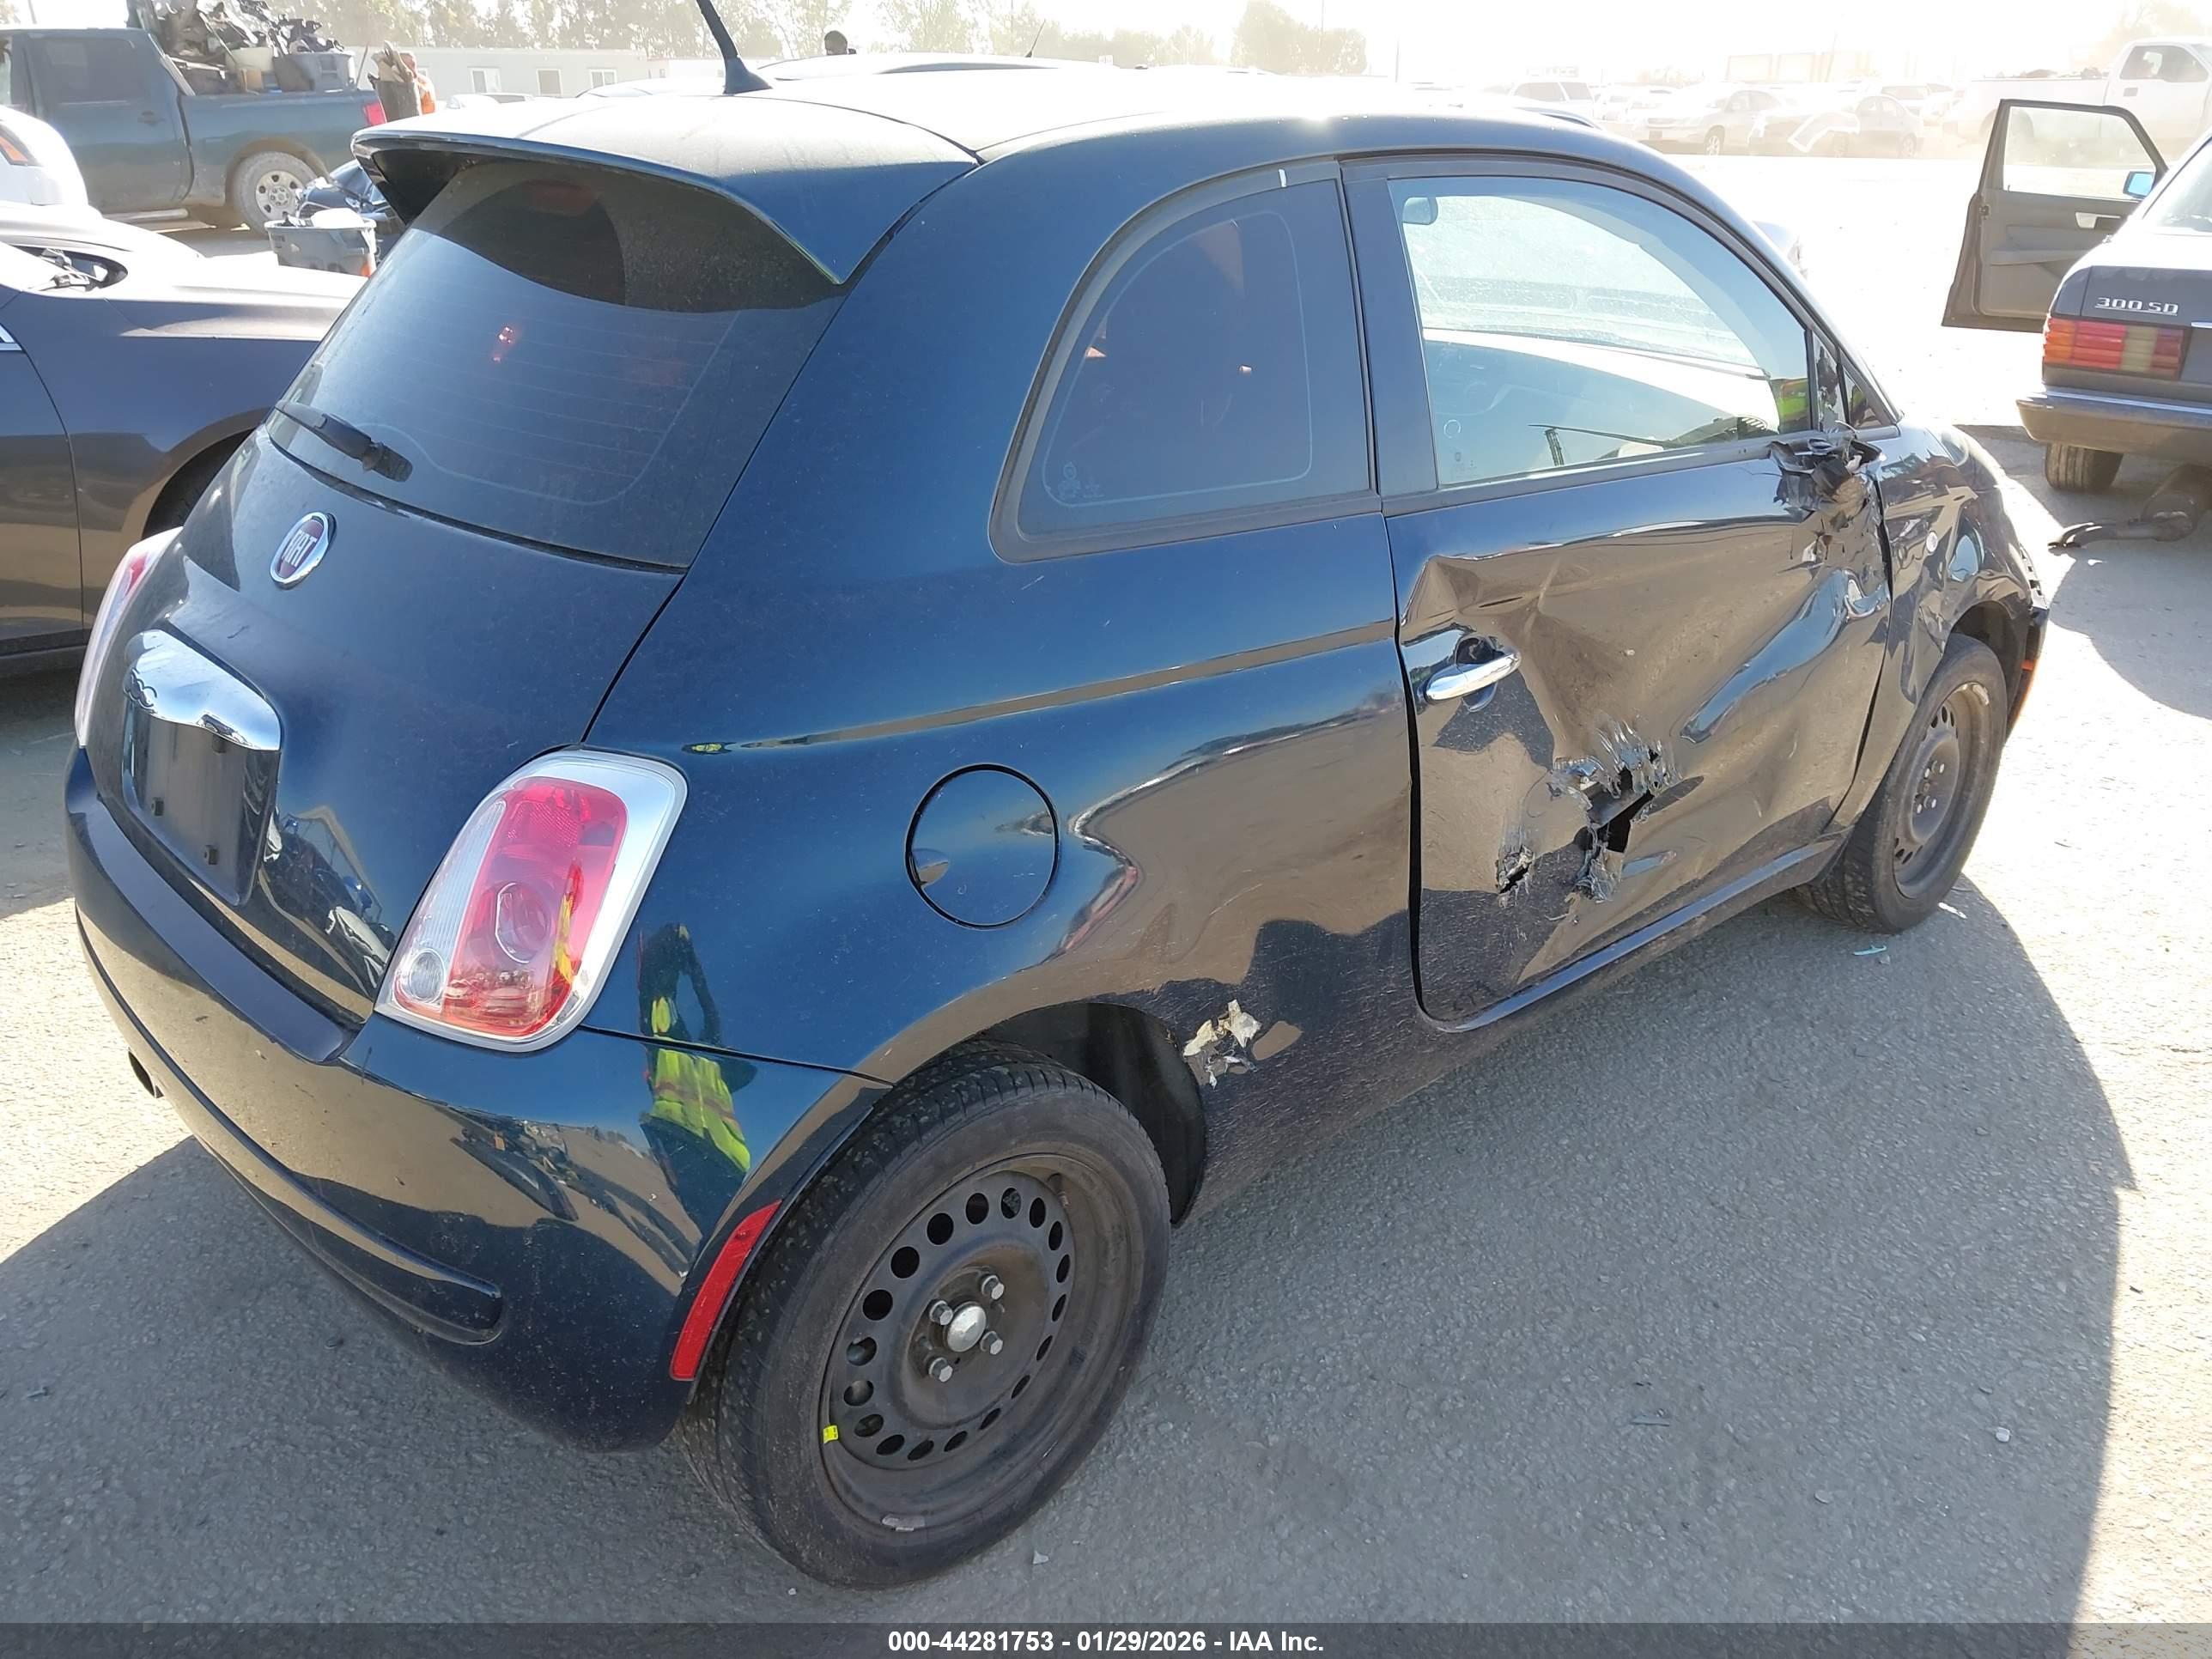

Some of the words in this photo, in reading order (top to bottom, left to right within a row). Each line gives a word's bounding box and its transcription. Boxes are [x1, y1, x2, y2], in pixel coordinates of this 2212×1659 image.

[2096, 297, 2143, 311] 300
[2148, 301, 2179, 314] SD
[281, 529, 318, 568] FIAT
